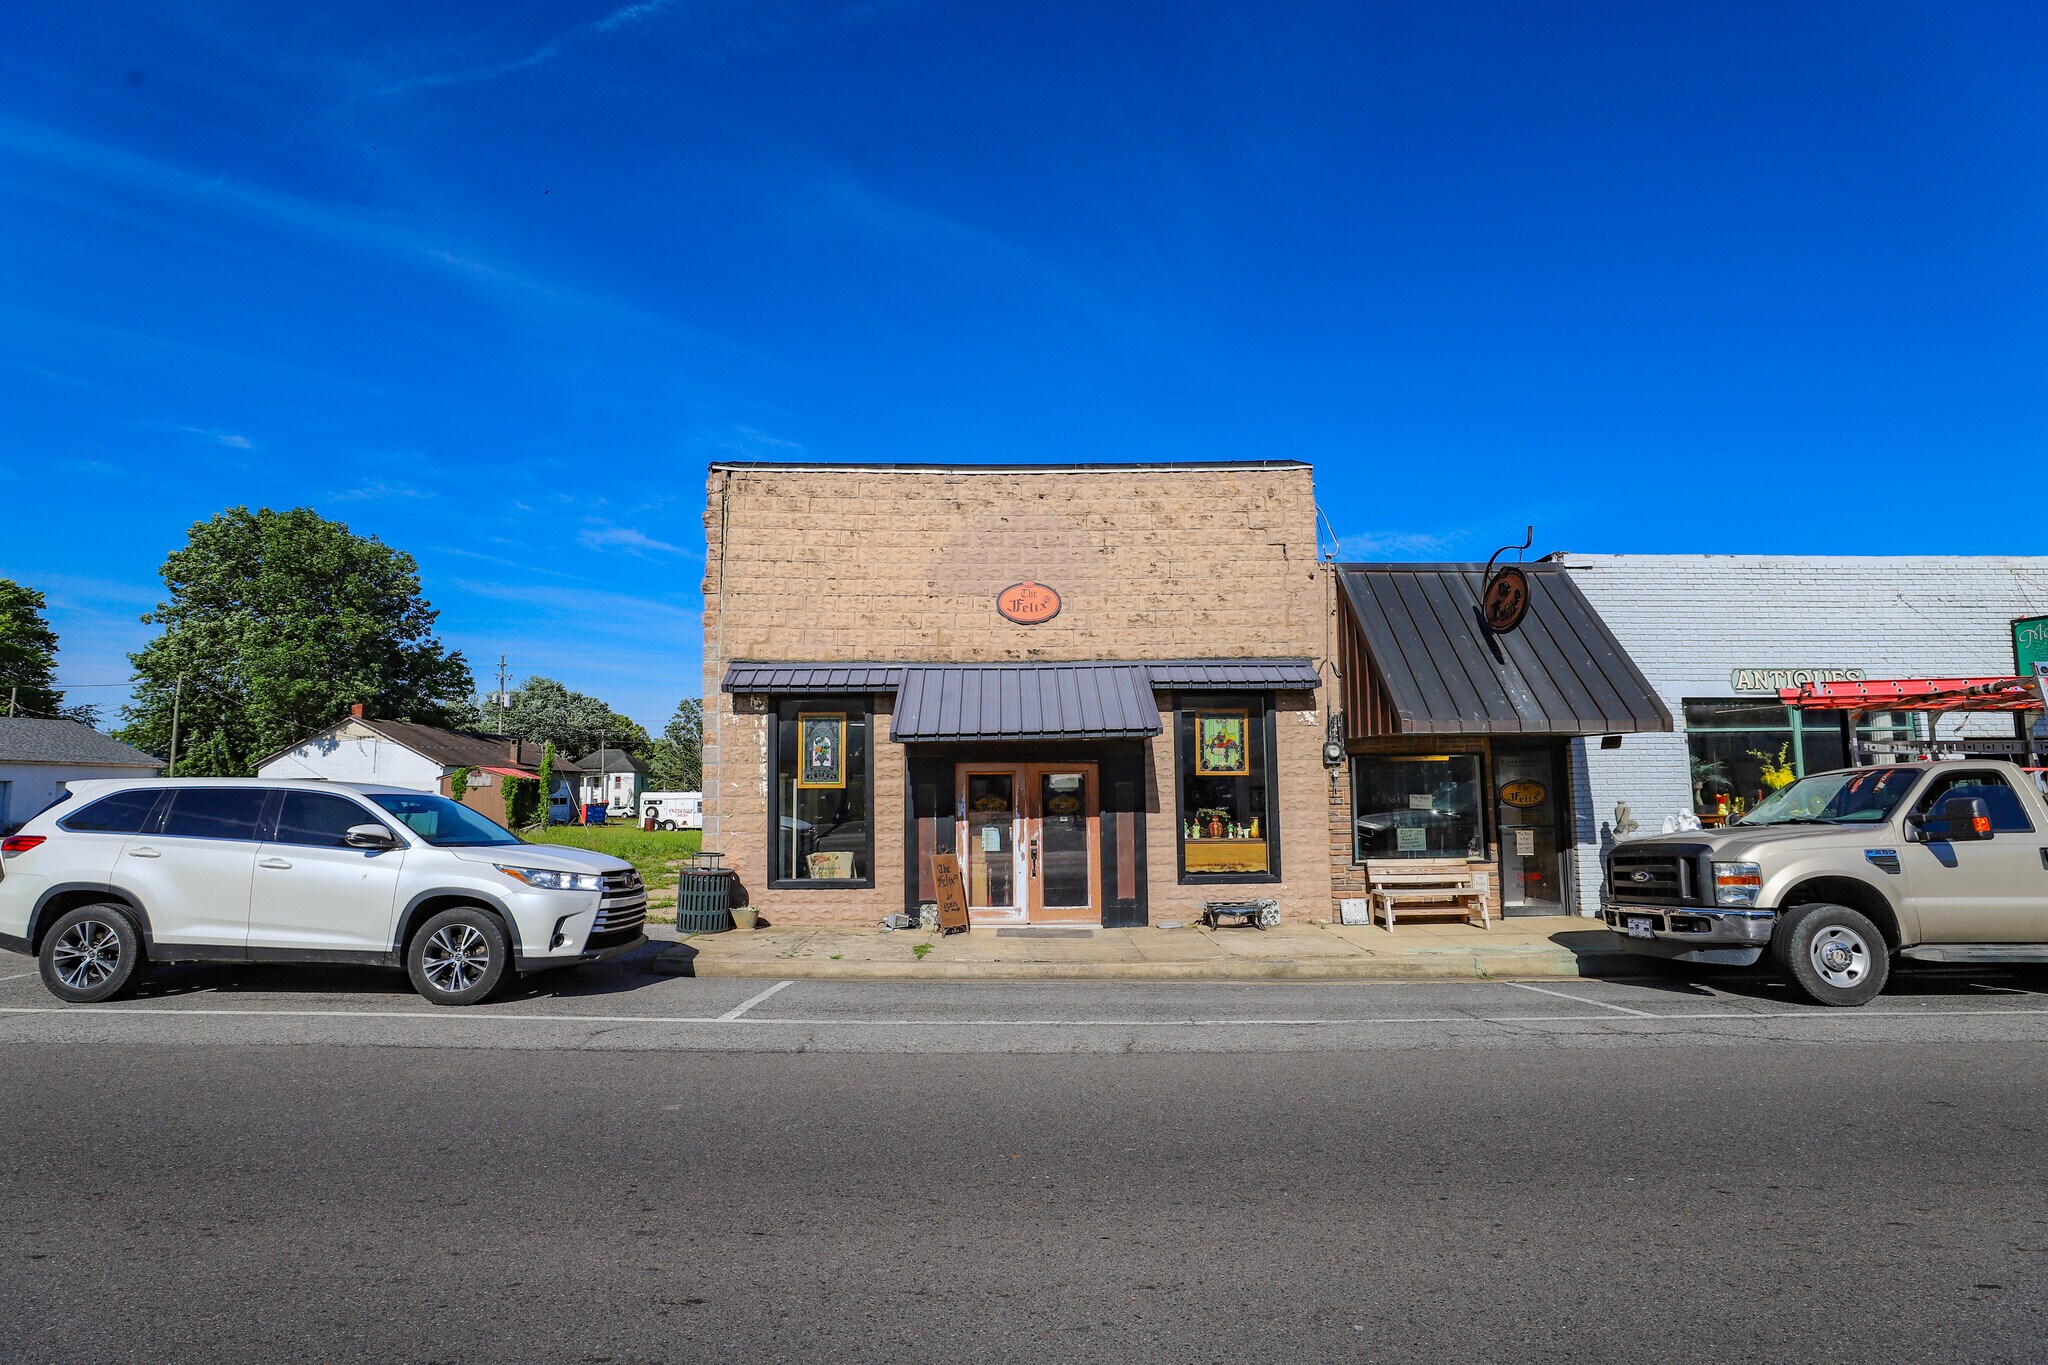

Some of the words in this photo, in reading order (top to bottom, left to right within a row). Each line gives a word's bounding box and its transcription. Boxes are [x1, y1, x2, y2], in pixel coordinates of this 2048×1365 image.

[1020, 589, 1037, 598] The
[1007, 599, 1047, 613] Felix
[1735, 669, 1861, 690] ANTIQUES
[1508, 792, 1539, 803] Felix
[937, 864, 951, 874] The
